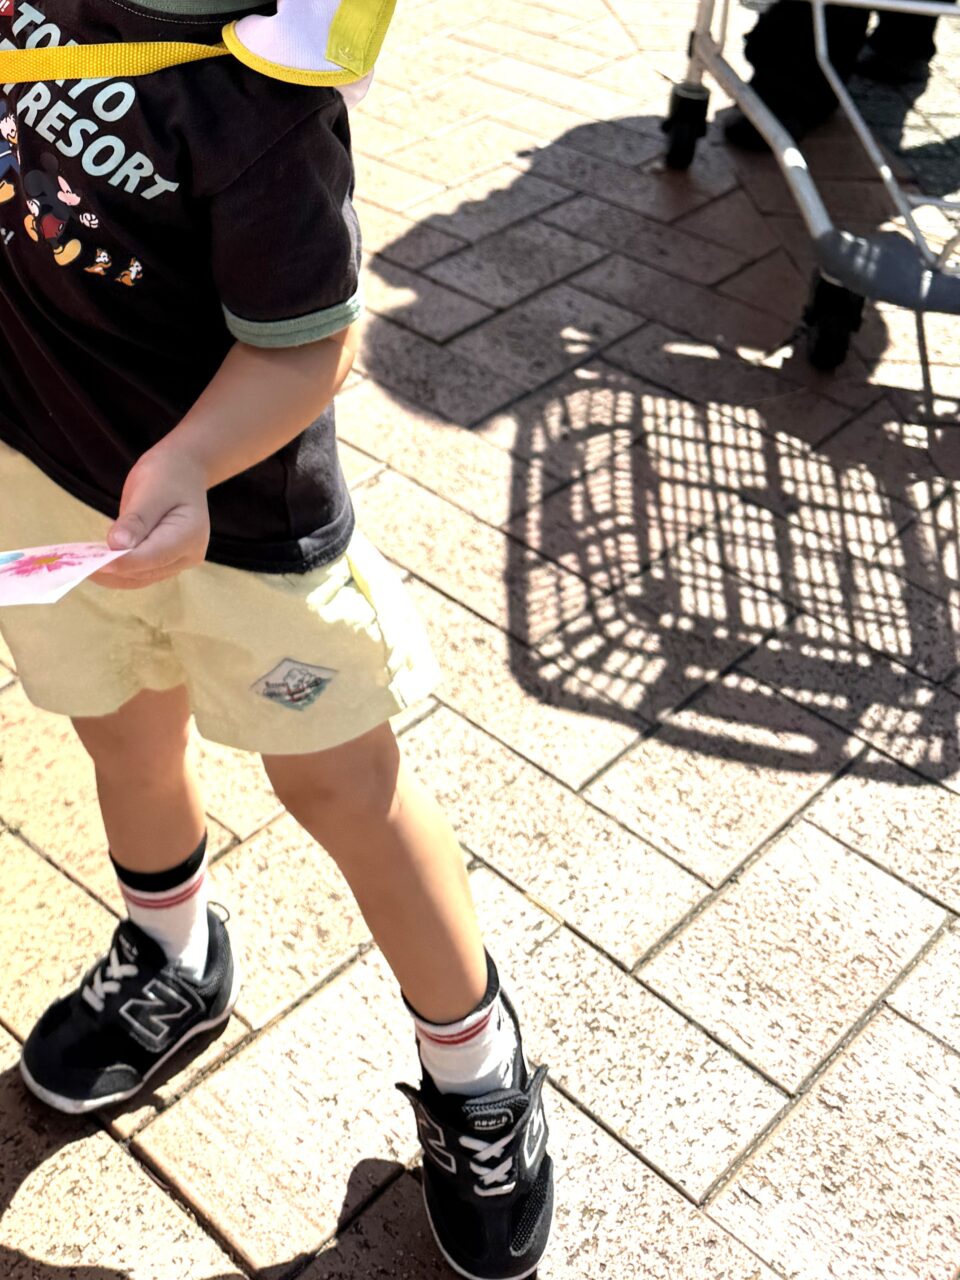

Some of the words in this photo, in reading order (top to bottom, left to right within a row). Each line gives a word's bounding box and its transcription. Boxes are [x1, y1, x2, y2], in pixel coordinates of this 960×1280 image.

[12, 1, 136, 122] TOYO
[16, 81, 180, 200] RESORT
[118, 977, 193, 1041] N
